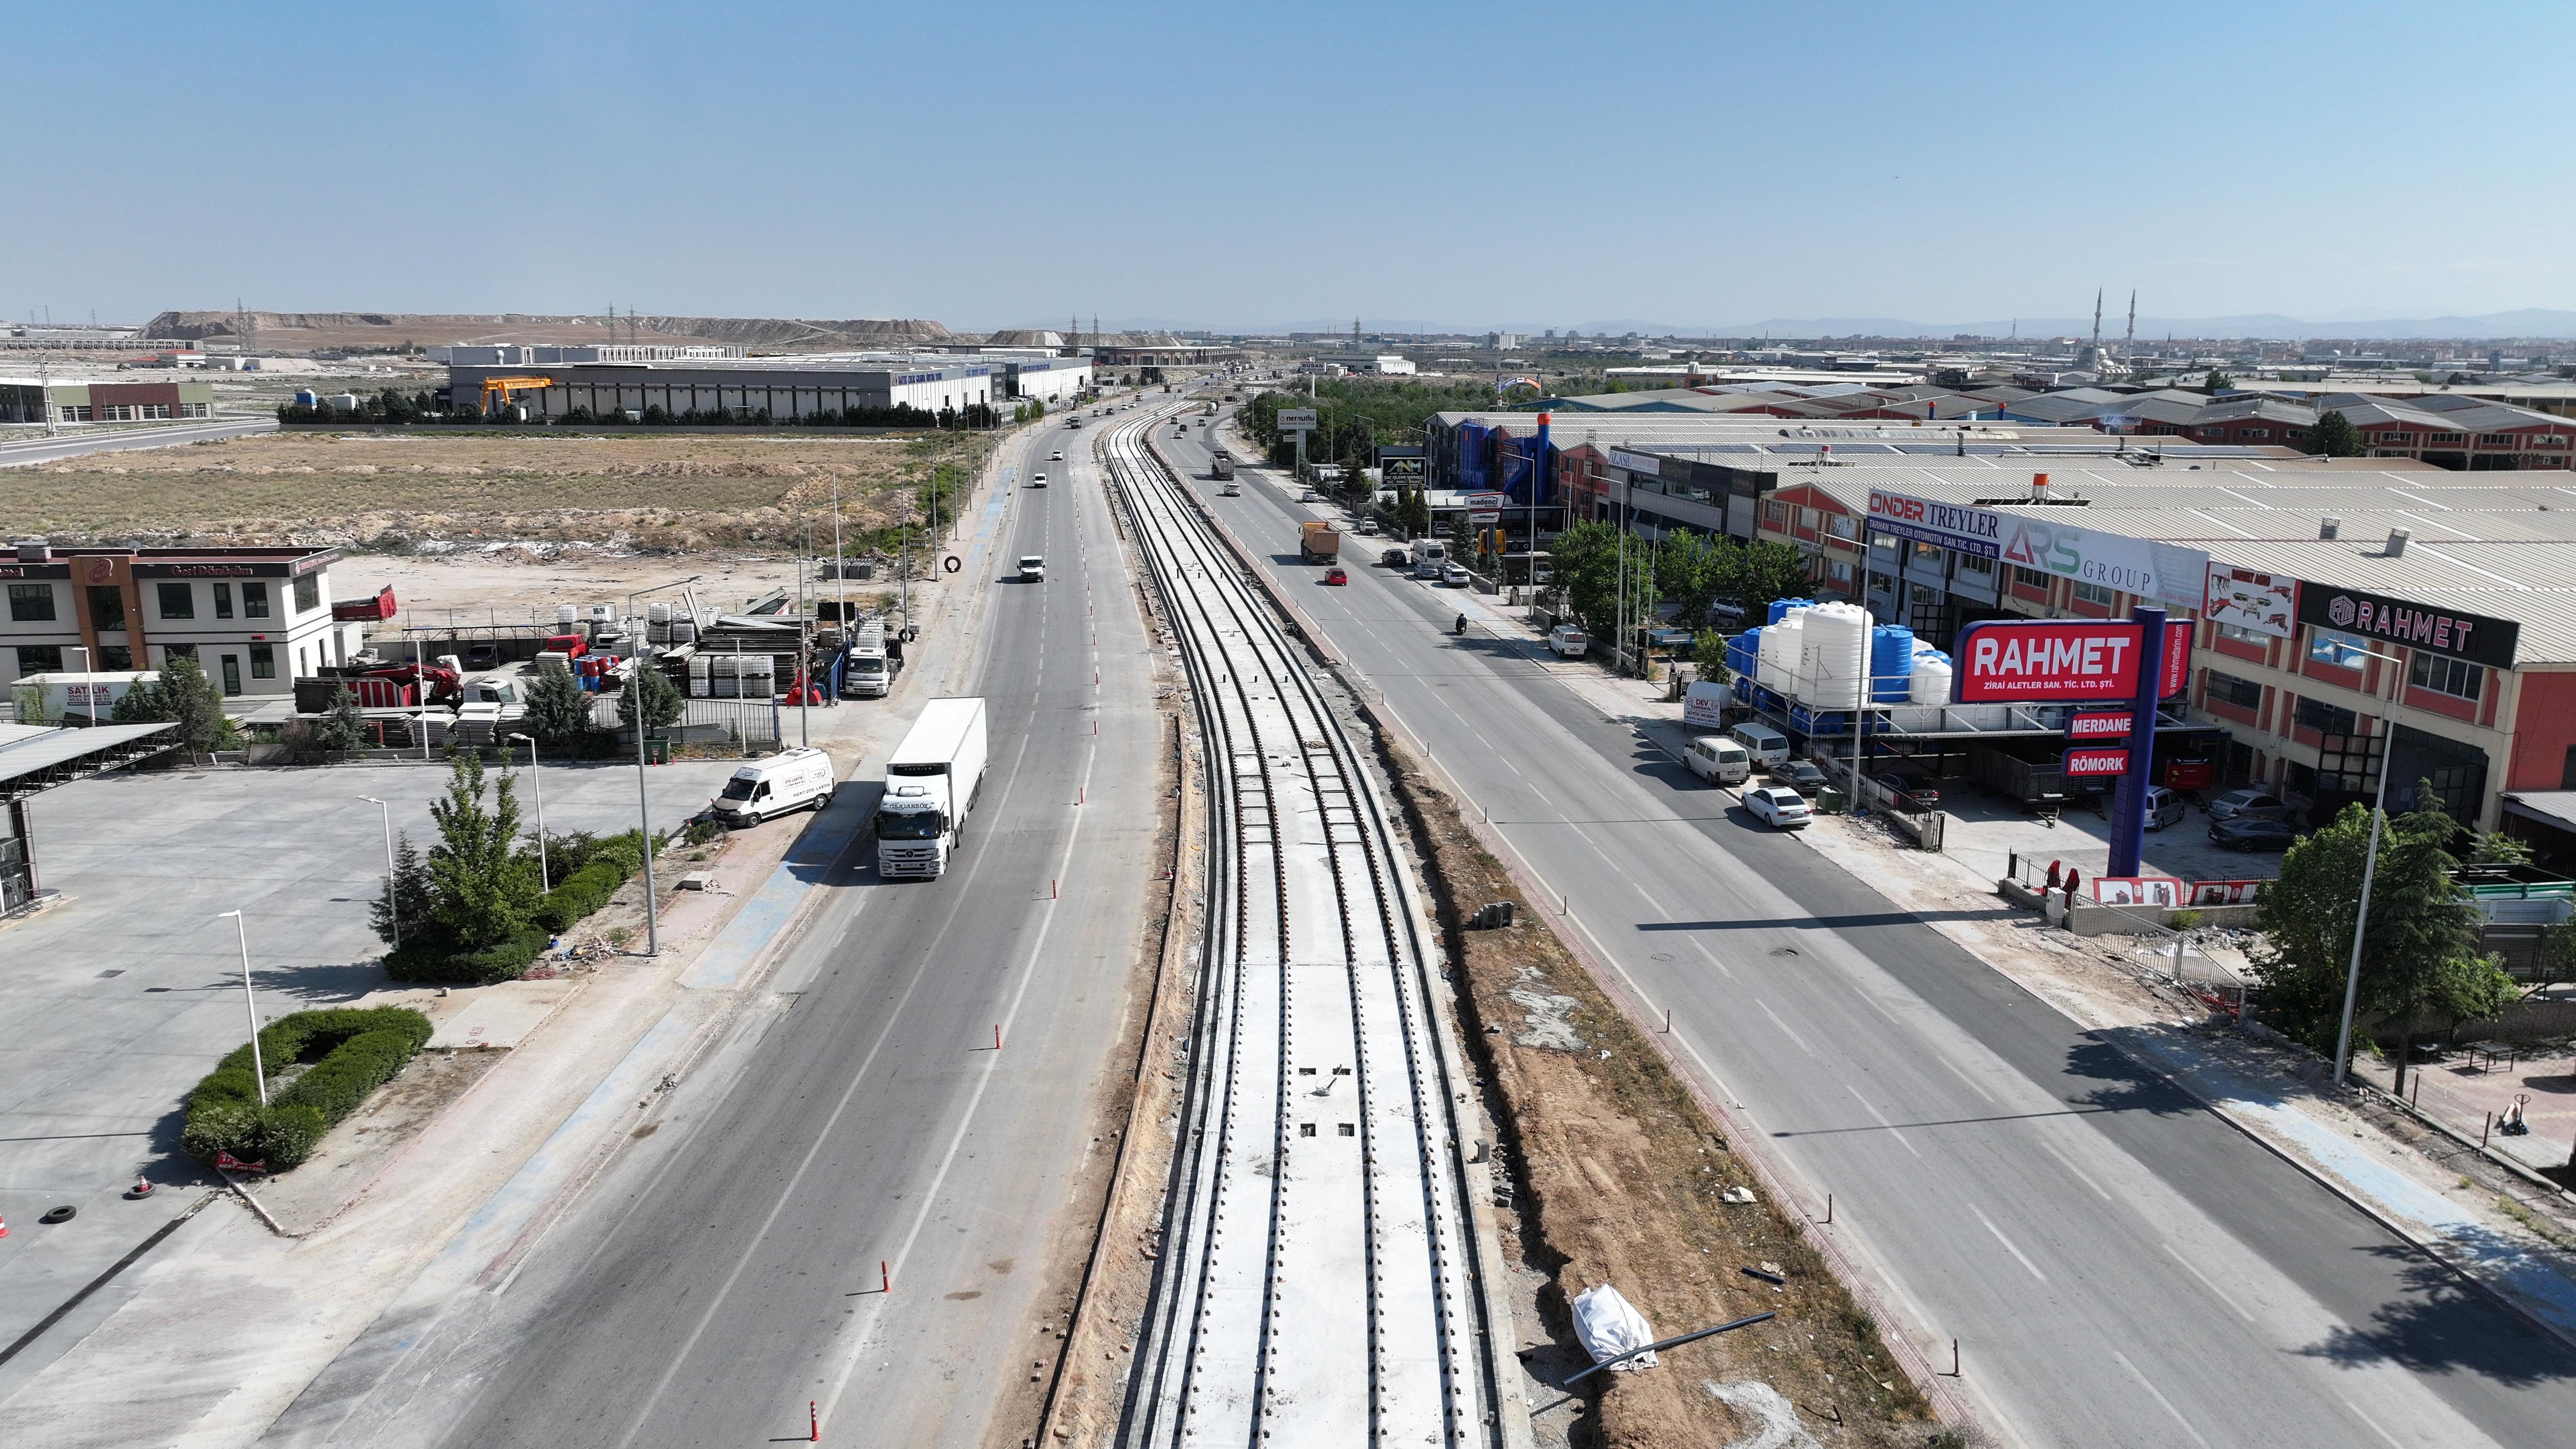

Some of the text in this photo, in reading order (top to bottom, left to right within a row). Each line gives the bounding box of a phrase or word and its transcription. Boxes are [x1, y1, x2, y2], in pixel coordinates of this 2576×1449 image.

[1869, 519, 1889, 532] TARHAN
[1890, 524, 1912, 536] TREYLER
[1970, 542, 1982, 553] LTD.
[1929, 504, 1998, 538] TREYLER
[2003, 521, 2082, 575] ARS
[171, 566, 197, 575] Geri
[2083, 560, 2150, 591] GROUP
[2357, 601, 2472, 652] RAHMET
[1974, 637, 2130, 676] RAHMET
[2170, 625, 2183, 688] www.rahmettarim.com
[1984, 680, 2005, 690] ZİRAİ
[2006, 681, 2042, 689] ALETLER
[2064, 679, 2078, 688] TİC.
[2100, 679, 2114, 689] ŞTİ.
[2071, 718, 2131, 733] MERDANE
[2070, 756, 2124, 772] RÖMORK
